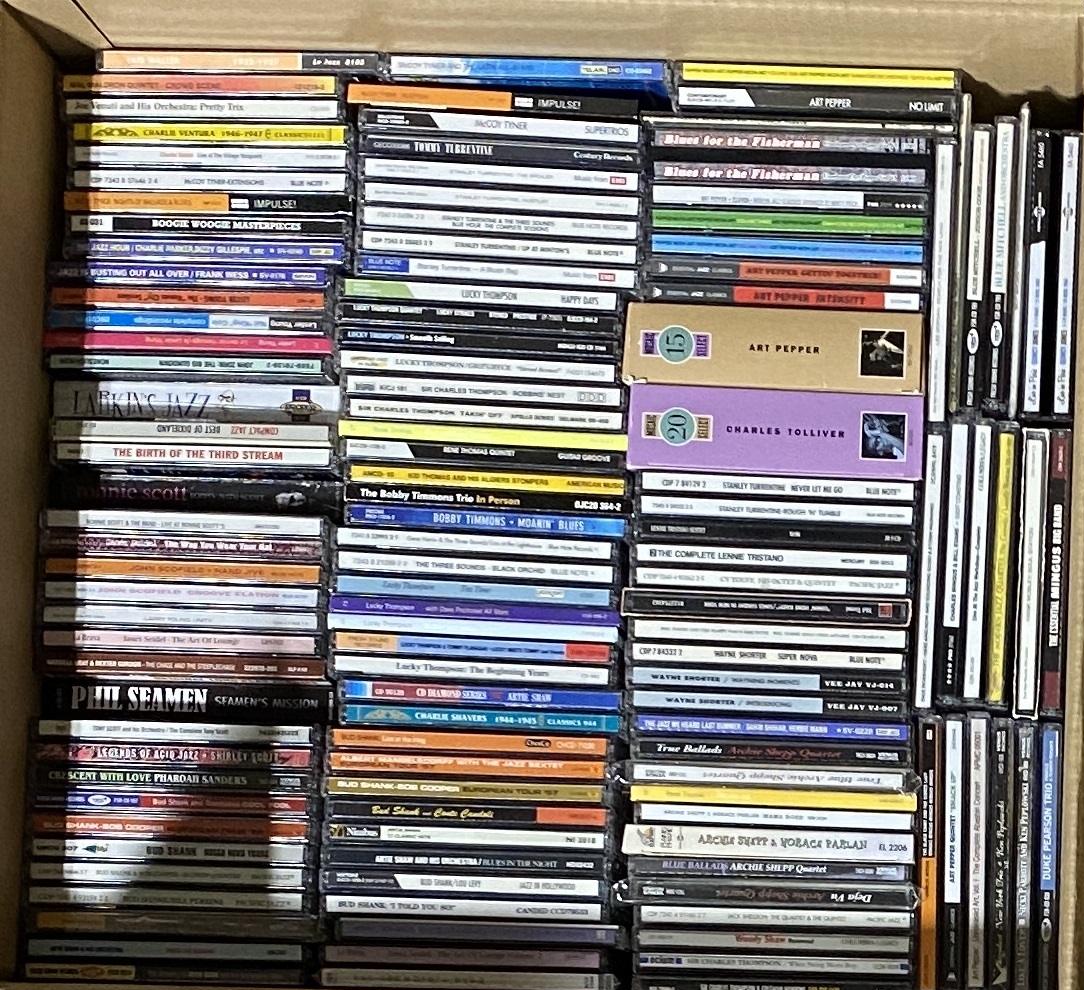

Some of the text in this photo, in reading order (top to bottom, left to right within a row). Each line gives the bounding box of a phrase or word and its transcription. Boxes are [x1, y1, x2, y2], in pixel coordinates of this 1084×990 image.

[538, 100, 581, 109] IMPULSE!
[809, 98, 943, 112] ART PEPPER NO LIMIT
[585, 125, 629, 136] SUPERTRIOS
[664, 134, 698, 145] Blues
[702, 135, 723, 146] for
[727, 137, 747, 147] the
[751, 137, 821, 149] Fisherman
[664, 167, 820, 181] Blues for the Fisherman
[254, 199, 297, 208] IMPULSE!
[152, 219, 301, 231] BOOGIE WOOGIE MASTERPIECES
[130, 269, 190, 278] OUT ALL OVER
[666, 334, 685, 355] 15
[749, 344, 820, 355] ART PEPPER
[163, 392, 210, 418] JAZZ
[668, 414, 688, 440] 20
[727, 426, 845, 438] CHARLES TOLLIVER
[114, 448, 283, 461] THE BIRTH OF THE THIRD STREAM
[360, 489, 474, 502] The Bobby Trio
[433, 513, 584, 531] BOBBY TIMMONS BLUES
[675, 550, 715, 559] COMPLETE
[1050, 547, 1061, 598] MINGUS
[72, 686, 319, 712] PHIL SEAMEN MISSION
[141, 750, 198, 761] OF JAZZ
[683, 744, 722, 754] Ballads
[126, 773, 151, 782] LOVE
[1044, 813, 1052, 856] PEARSON
[1044, 858, 1052, 880] DUKE
